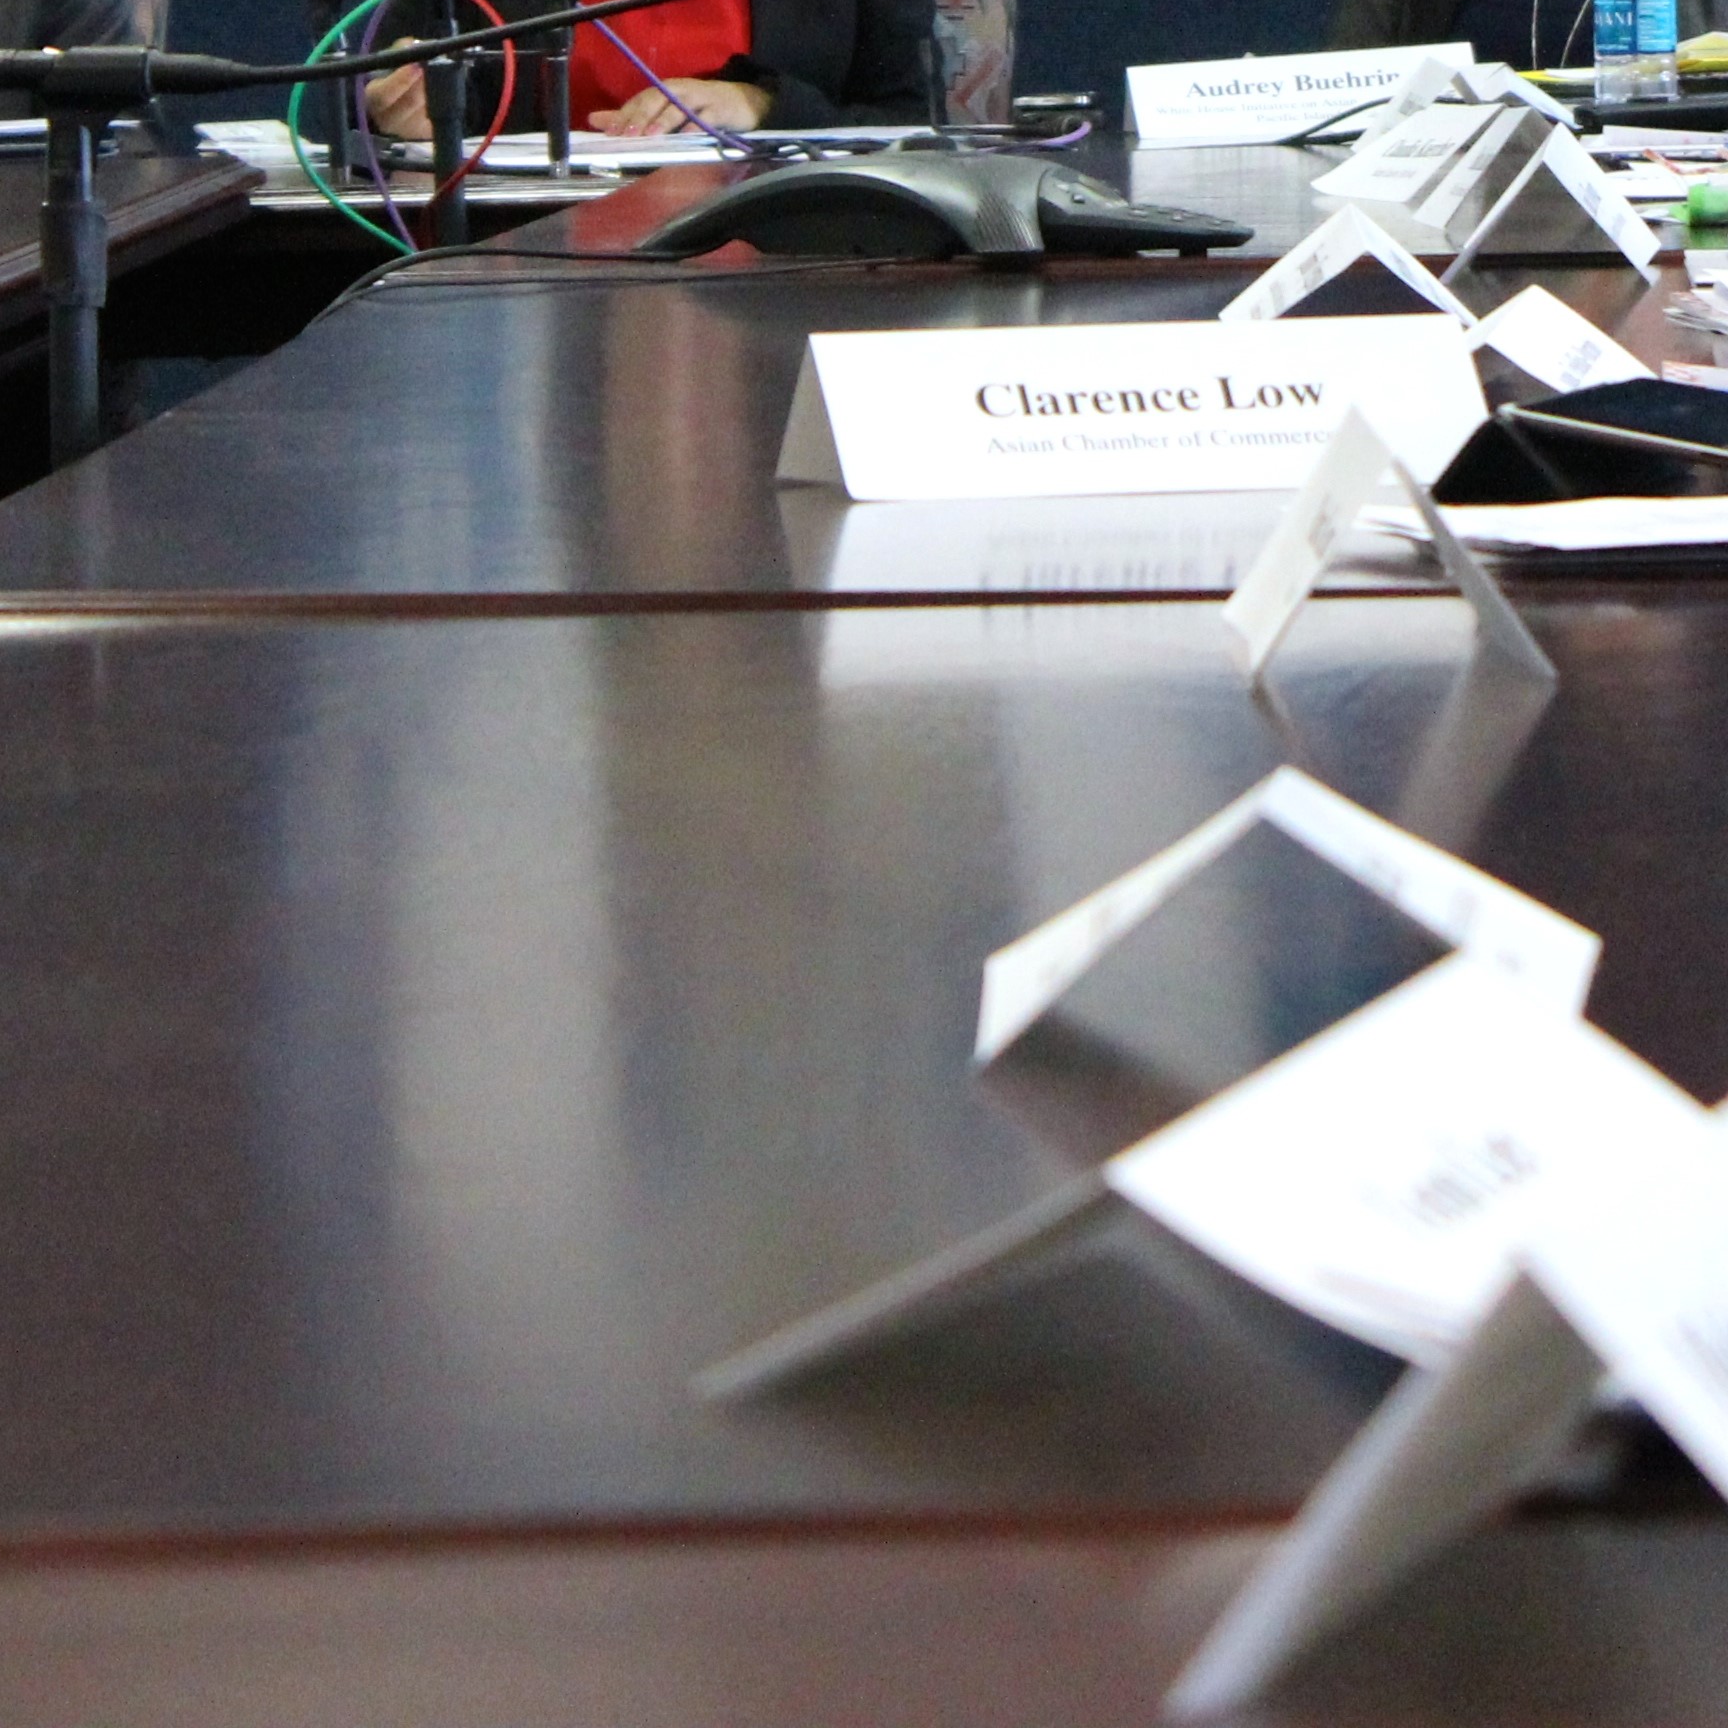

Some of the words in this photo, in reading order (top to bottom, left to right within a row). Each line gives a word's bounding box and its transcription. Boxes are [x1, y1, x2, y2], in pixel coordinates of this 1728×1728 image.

[1186, 77, 1284, 98] Audrey
[1294, 69, 1400, 92] Buehrin
[974, 381, 1202, 419] Clarence
[1215, 374, 1325, 411] Low
[986, 435, 1055, 455] Asian
[1062, 432, 1169, 453] Chamber
[1178, 430, 1202, 449] of
